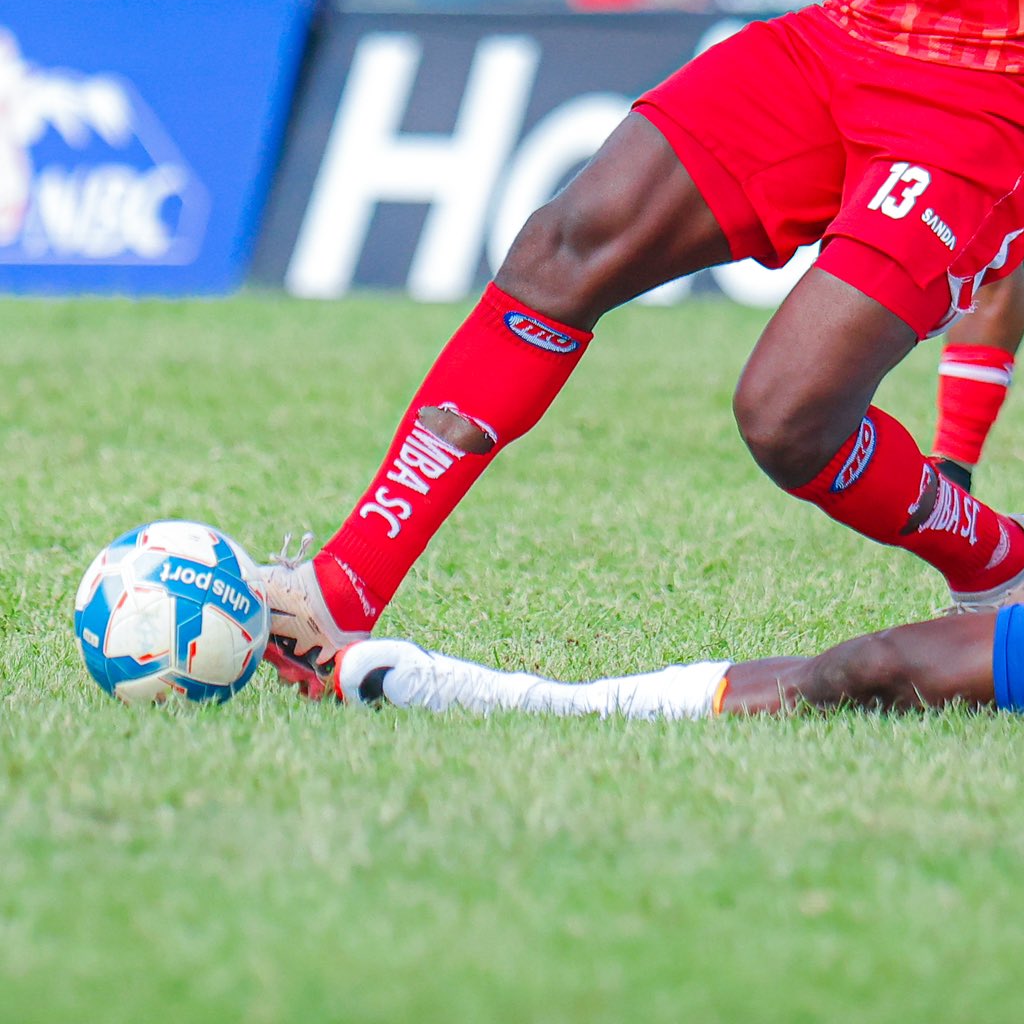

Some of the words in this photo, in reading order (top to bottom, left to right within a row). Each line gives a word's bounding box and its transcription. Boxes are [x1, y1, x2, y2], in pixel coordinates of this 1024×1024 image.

[867, 161, 931, 220] 13
[920, 208, 957, 251] SANDA
[387, 419, 466, 496] MBA
[359, 484, 413, 539] SC
[159, 561, 250, 615] uhlsport
